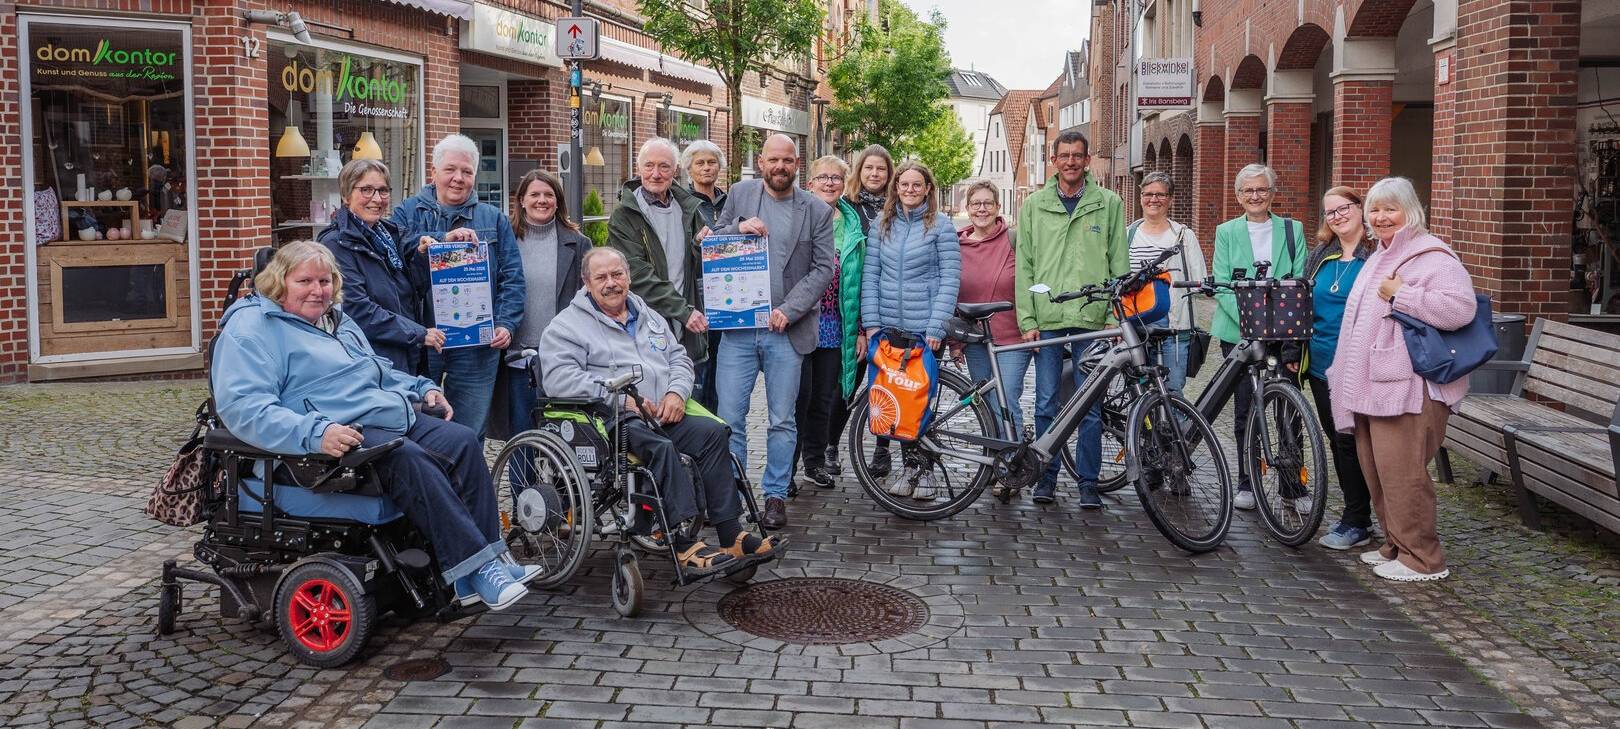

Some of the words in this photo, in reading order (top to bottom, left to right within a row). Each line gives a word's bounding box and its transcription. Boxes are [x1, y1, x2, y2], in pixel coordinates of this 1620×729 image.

[241, 36, 260, 57] 12
[37, 68, 59, 76] Kunst
[78, 69, 107, 77] Genuss
[126, 70, 142, 79] der
[142, 65, 175, 80] Region
[1141, 60, 1189, 76] Blickwinkel
[345, 102, 356, 114] Die
[359, 104, 408, 119] Genossenschaft
[887, 368, 922, 389] Tour
[578, 454, 595, 462] ROLLI
